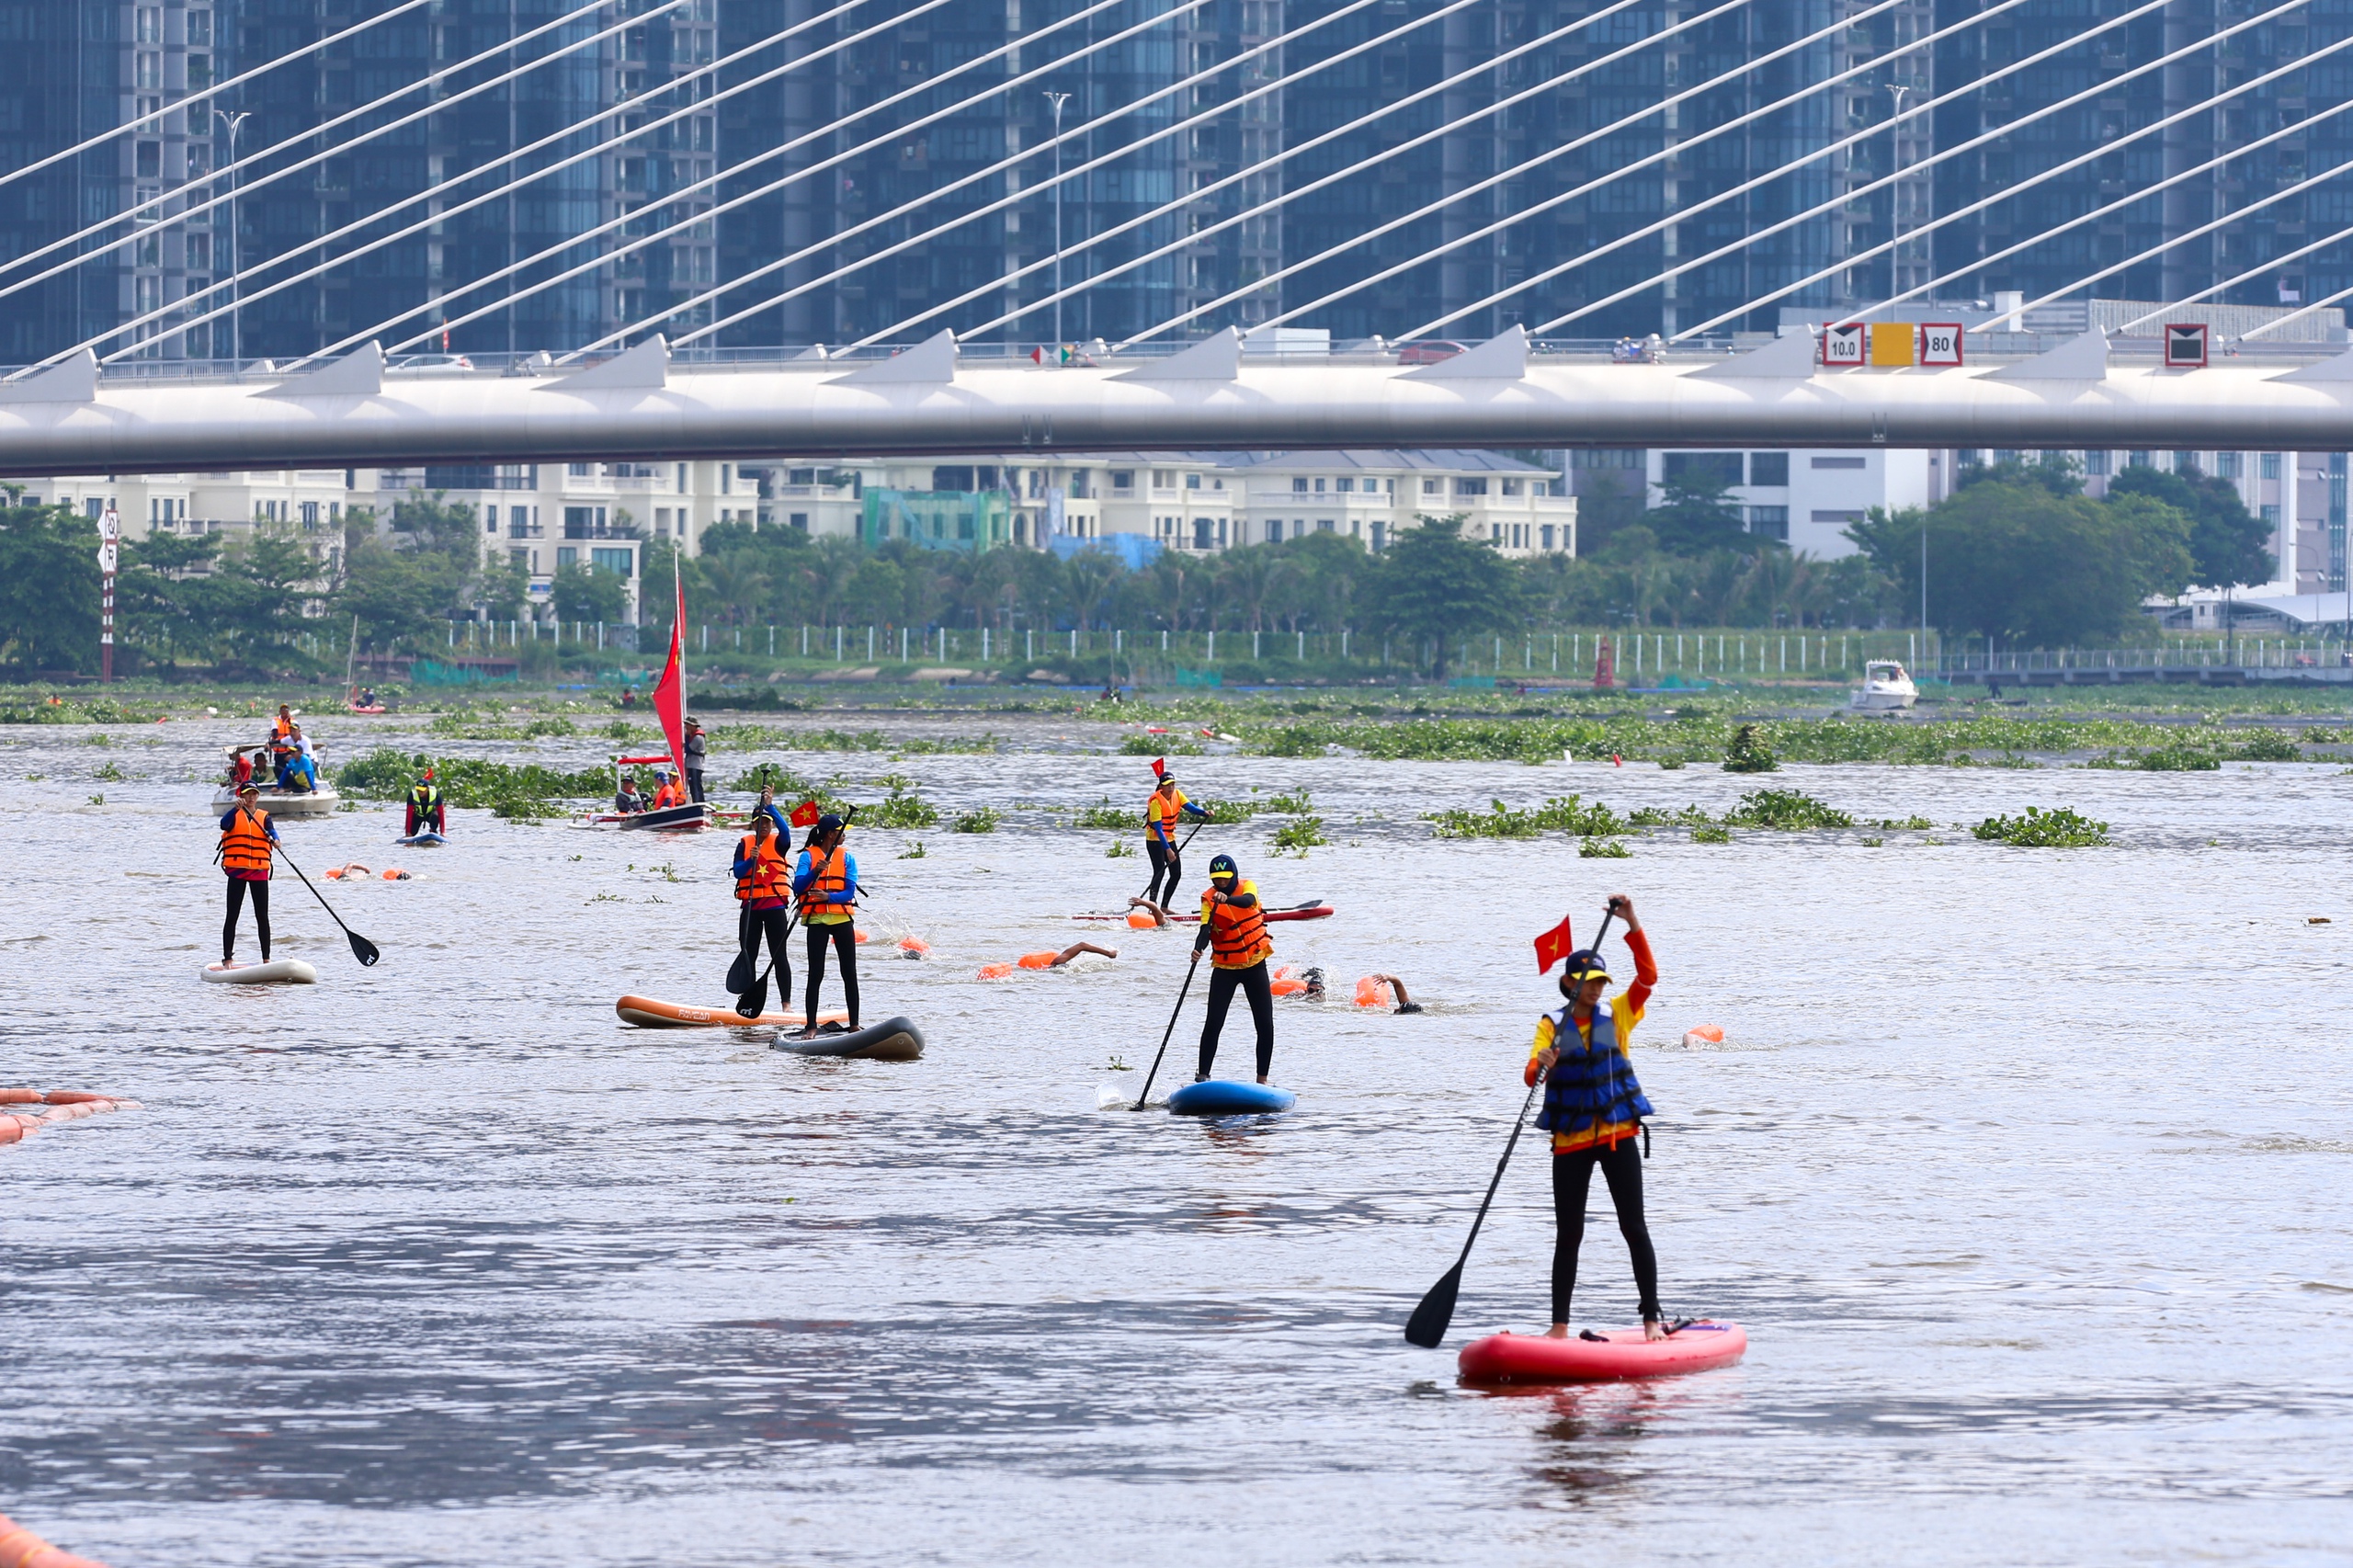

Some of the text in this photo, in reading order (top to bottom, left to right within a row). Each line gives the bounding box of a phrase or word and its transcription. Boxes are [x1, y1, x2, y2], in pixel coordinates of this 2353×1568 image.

[1833, 341, 1855, 356] 10.0
[1932, 336, 1949, 351] 80
[1213, 862, 1227, 870] W
